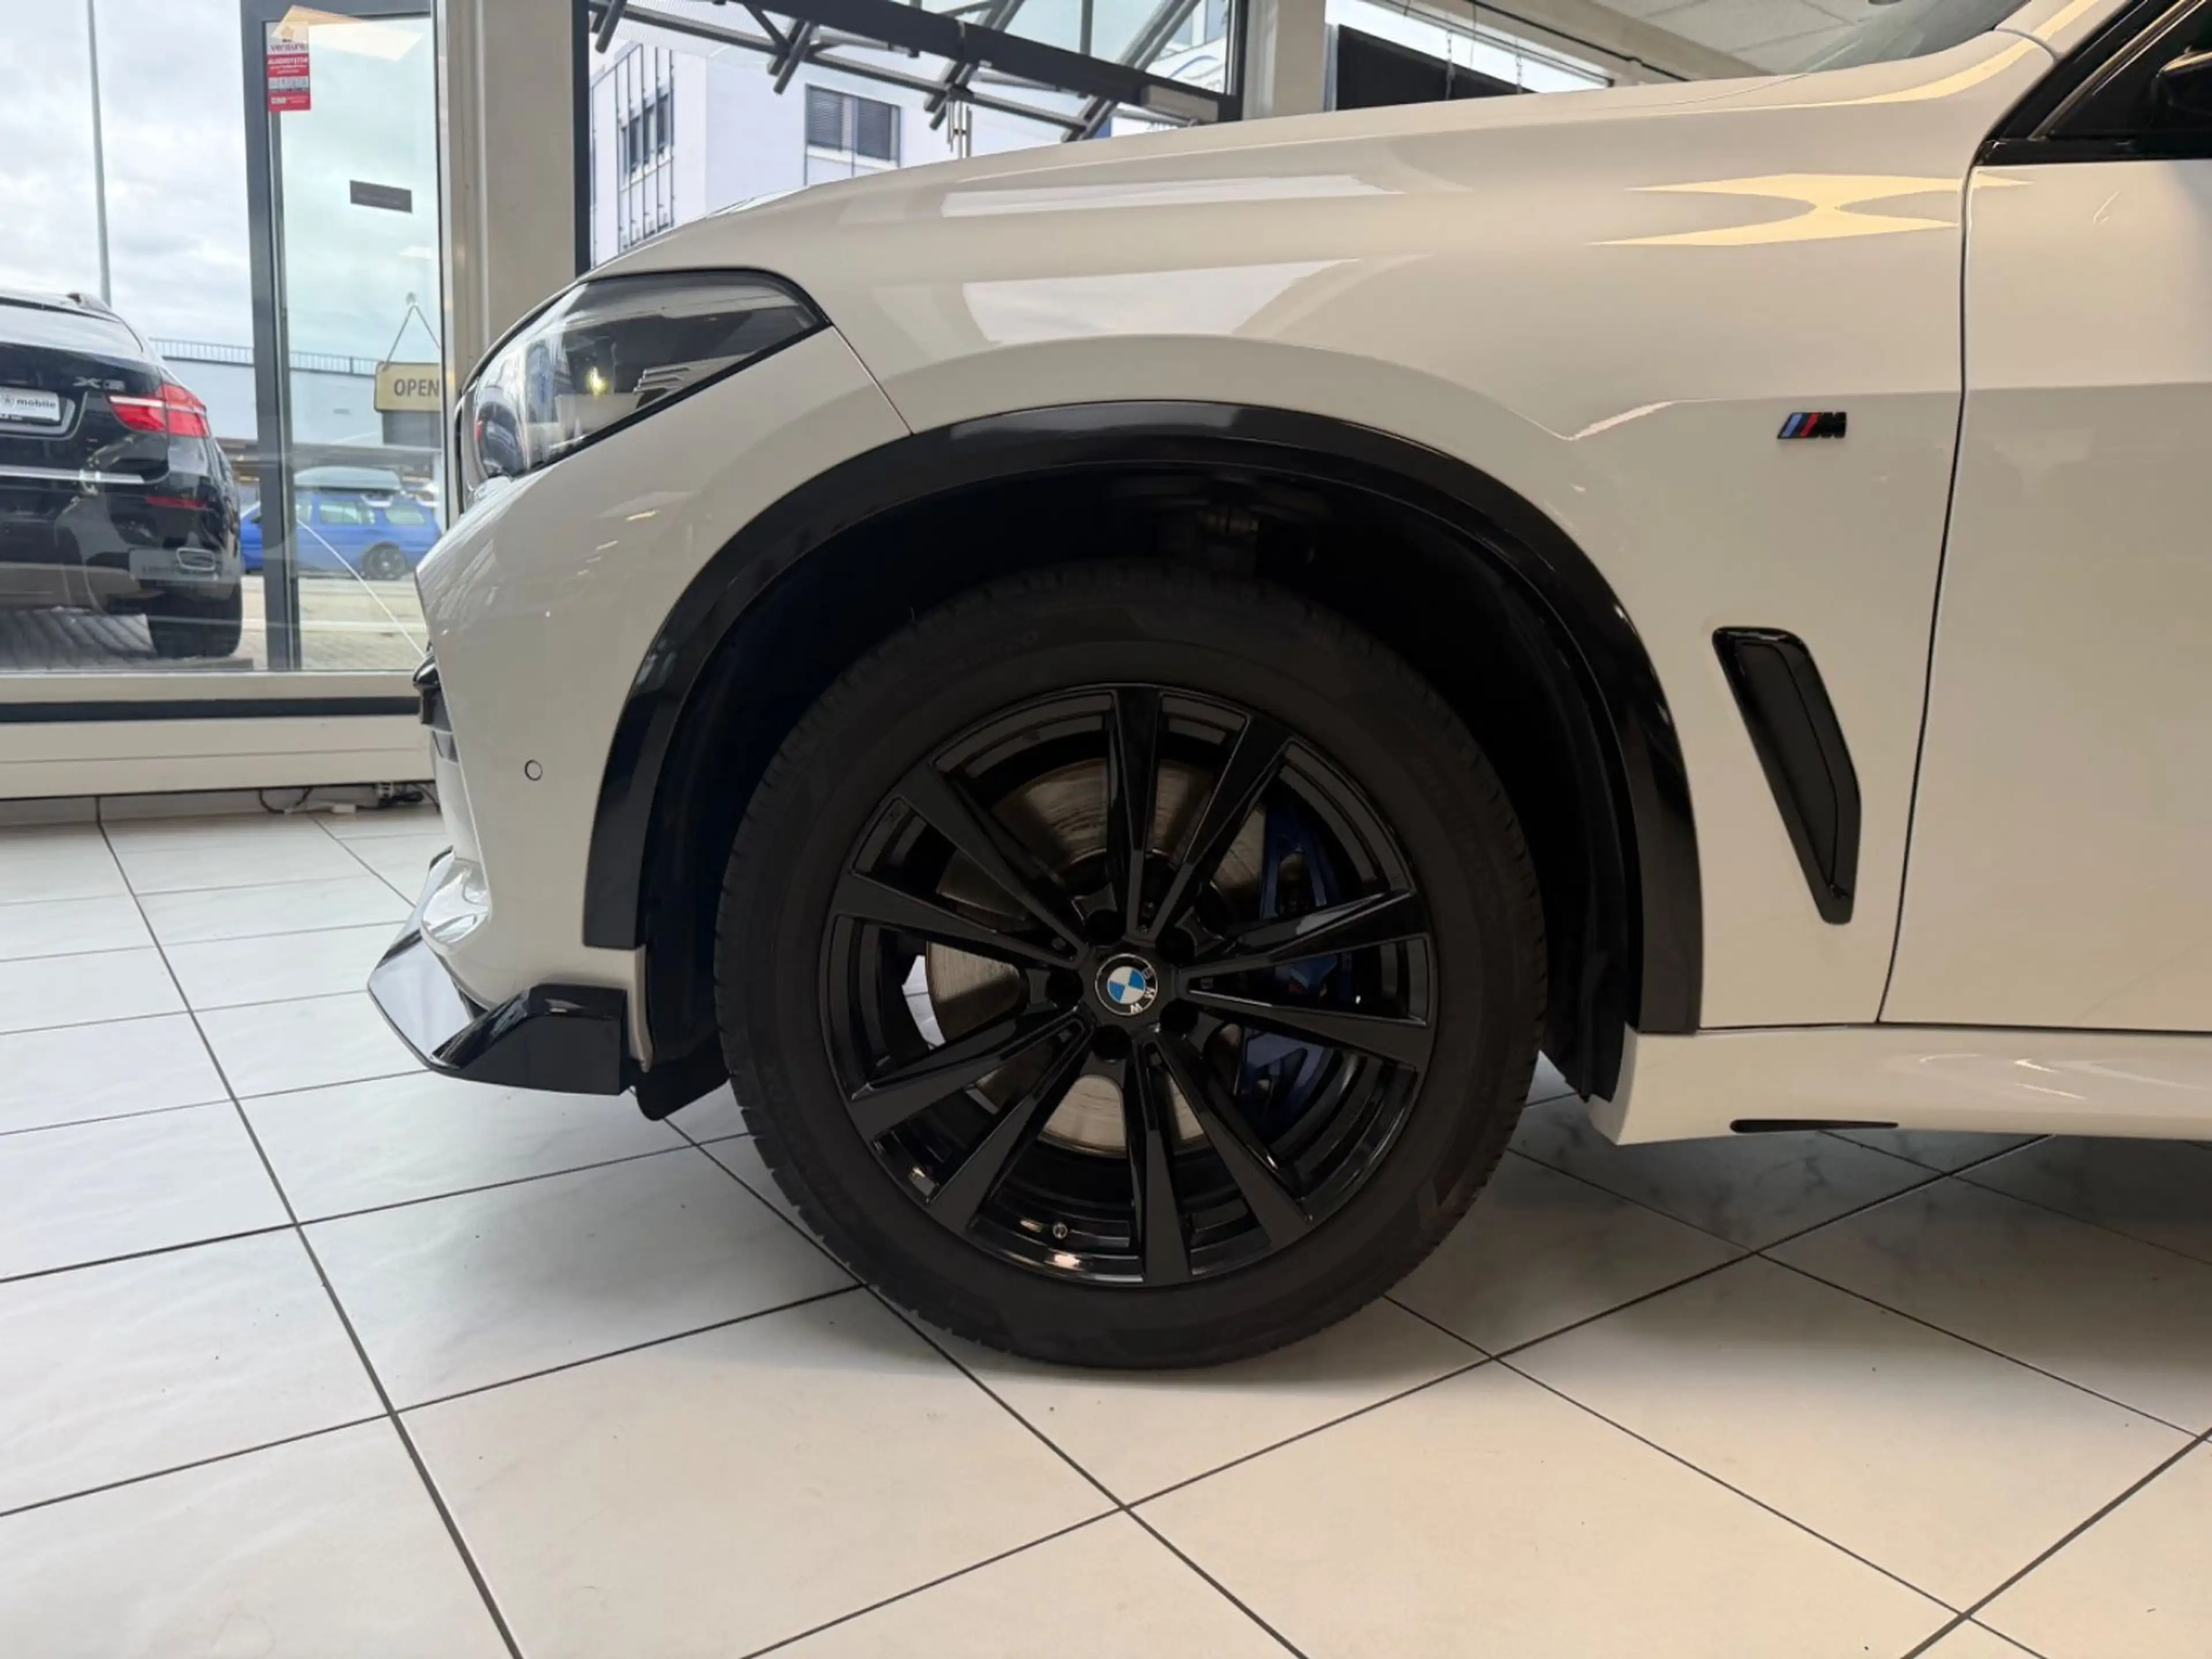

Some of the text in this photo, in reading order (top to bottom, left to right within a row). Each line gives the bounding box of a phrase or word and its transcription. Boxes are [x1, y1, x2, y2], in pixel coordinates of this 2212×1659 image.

[73, 376, 124, 391] X6
[394, 378, 439, 397] OPEN
[1130, 967, 1156, 1014] BMW
